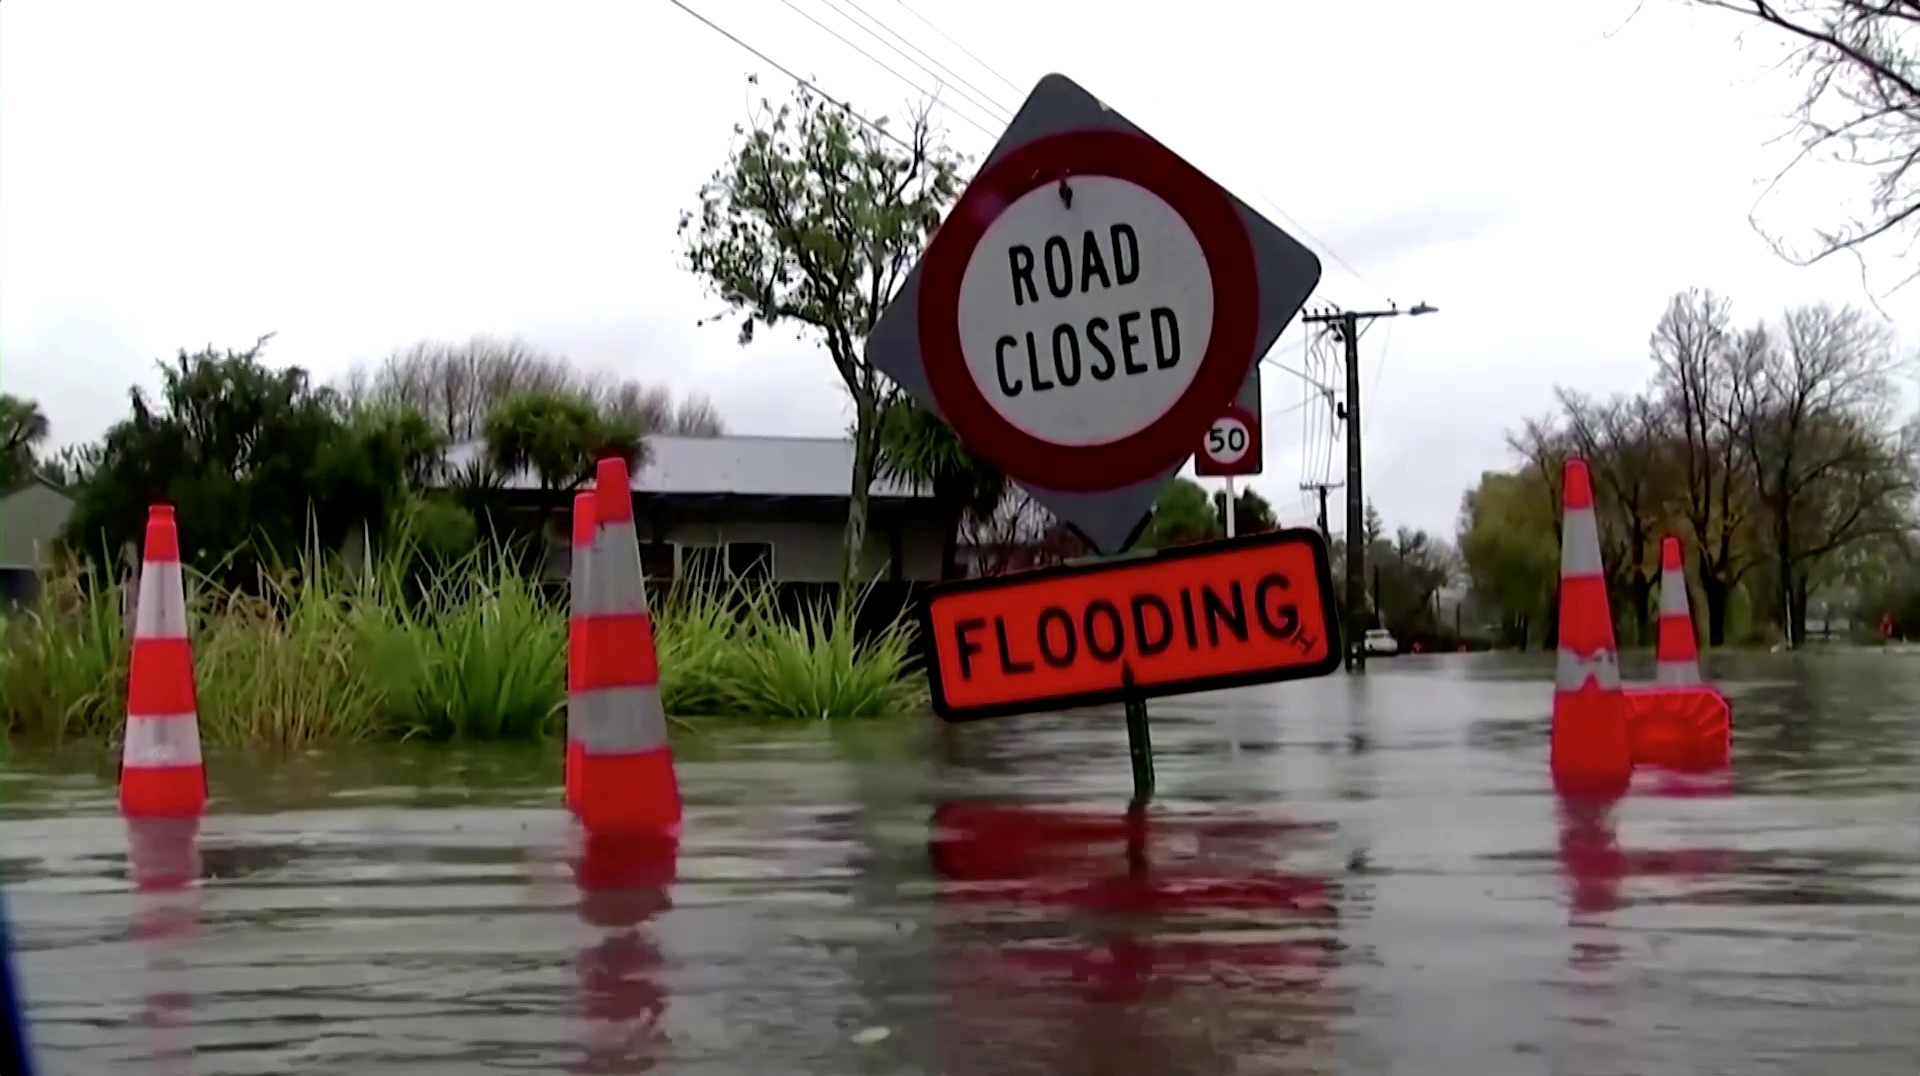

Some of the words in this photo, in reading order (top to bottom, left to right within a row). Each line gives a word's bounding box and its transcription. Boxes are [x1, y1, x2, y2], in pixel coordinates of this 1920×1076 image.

[1008, 223, 1140, 306] ROAD
[995, 306, 1181, 397] CLOSED
[1209, 427, 1245, 453] 50
[954, 572, 1299, 682] FLOODING
